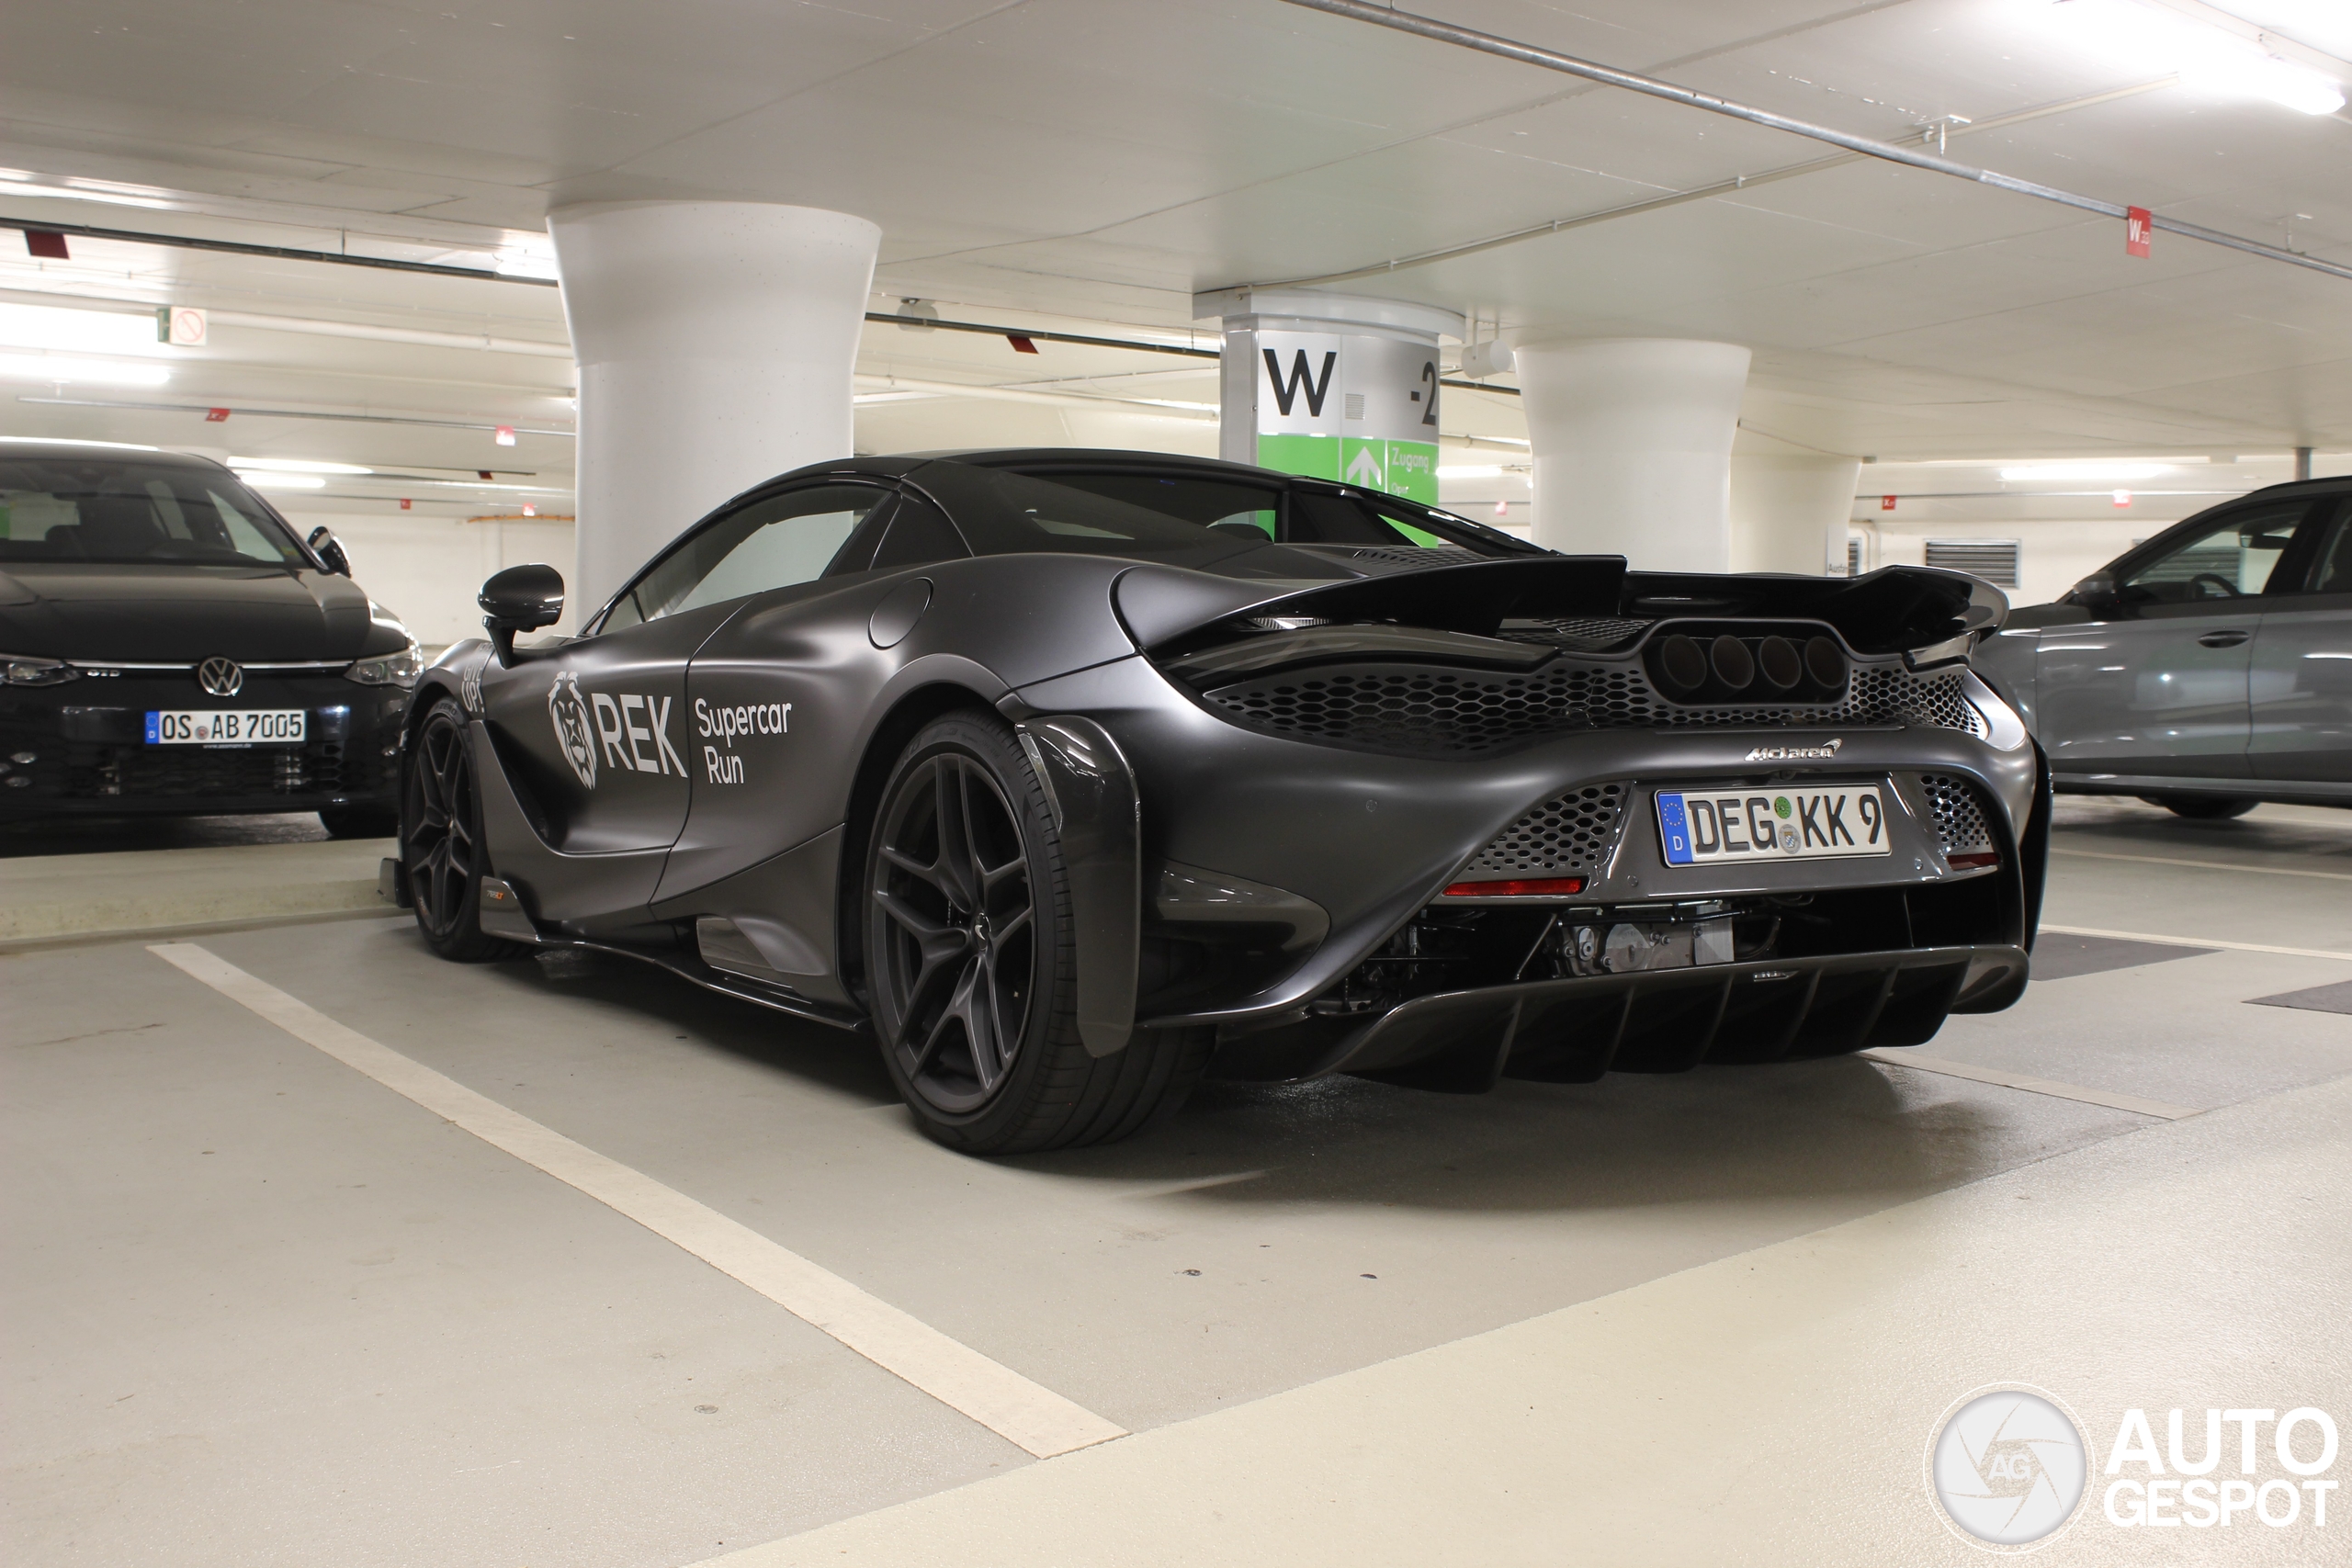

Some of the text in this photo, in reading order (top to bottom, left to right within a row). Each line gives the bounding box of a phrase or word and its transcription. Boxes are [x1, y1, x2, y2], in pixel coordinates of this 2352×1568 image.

[2129, 218, 2143, 243] W
[1262, 348, 1337, 417] W
[1410, 361, 1437, 426] -2
[1391, 447, 1430, 474] Zugang
[461, 681, 485, 713] UP!
[162, 714, 302, 739] OS AB 7005
[591, 693, 688, 778] REK
[695, 697, 792, 747] Supercar
[704, 746, 744, 784] Run
[1745, 746, 1835, 761] McLaren
[1688, 794, 1883, 854] DEG KK 9
[1672, 835, 1684, 852] D
